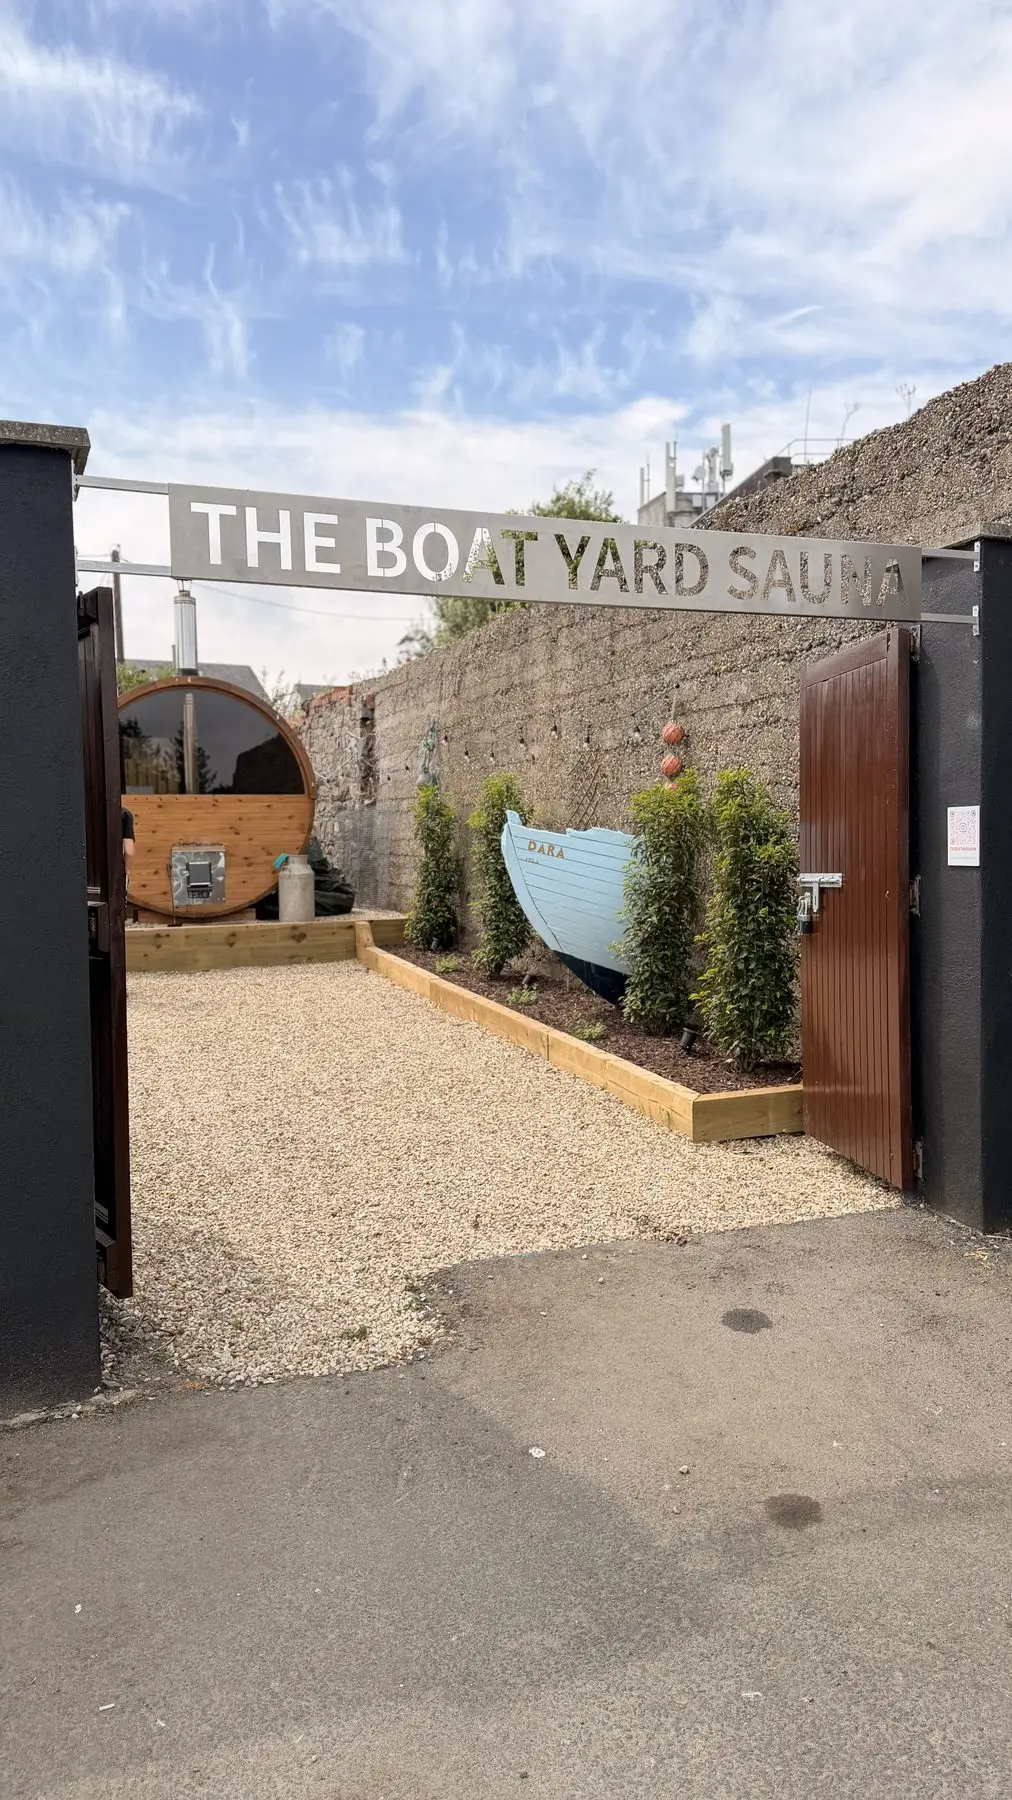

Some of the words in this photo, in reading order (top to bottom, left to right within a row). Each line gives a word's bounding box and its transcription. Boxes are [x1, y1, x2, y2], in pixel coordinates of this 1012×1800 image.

[190, 501, 341, 574] THE
[365, 517, 538, 587] BOAT
[553, 533, 709, 597] YARD
[727, 545, 907, 607] SAUNA
[528, 840, 564, 859] DARA
